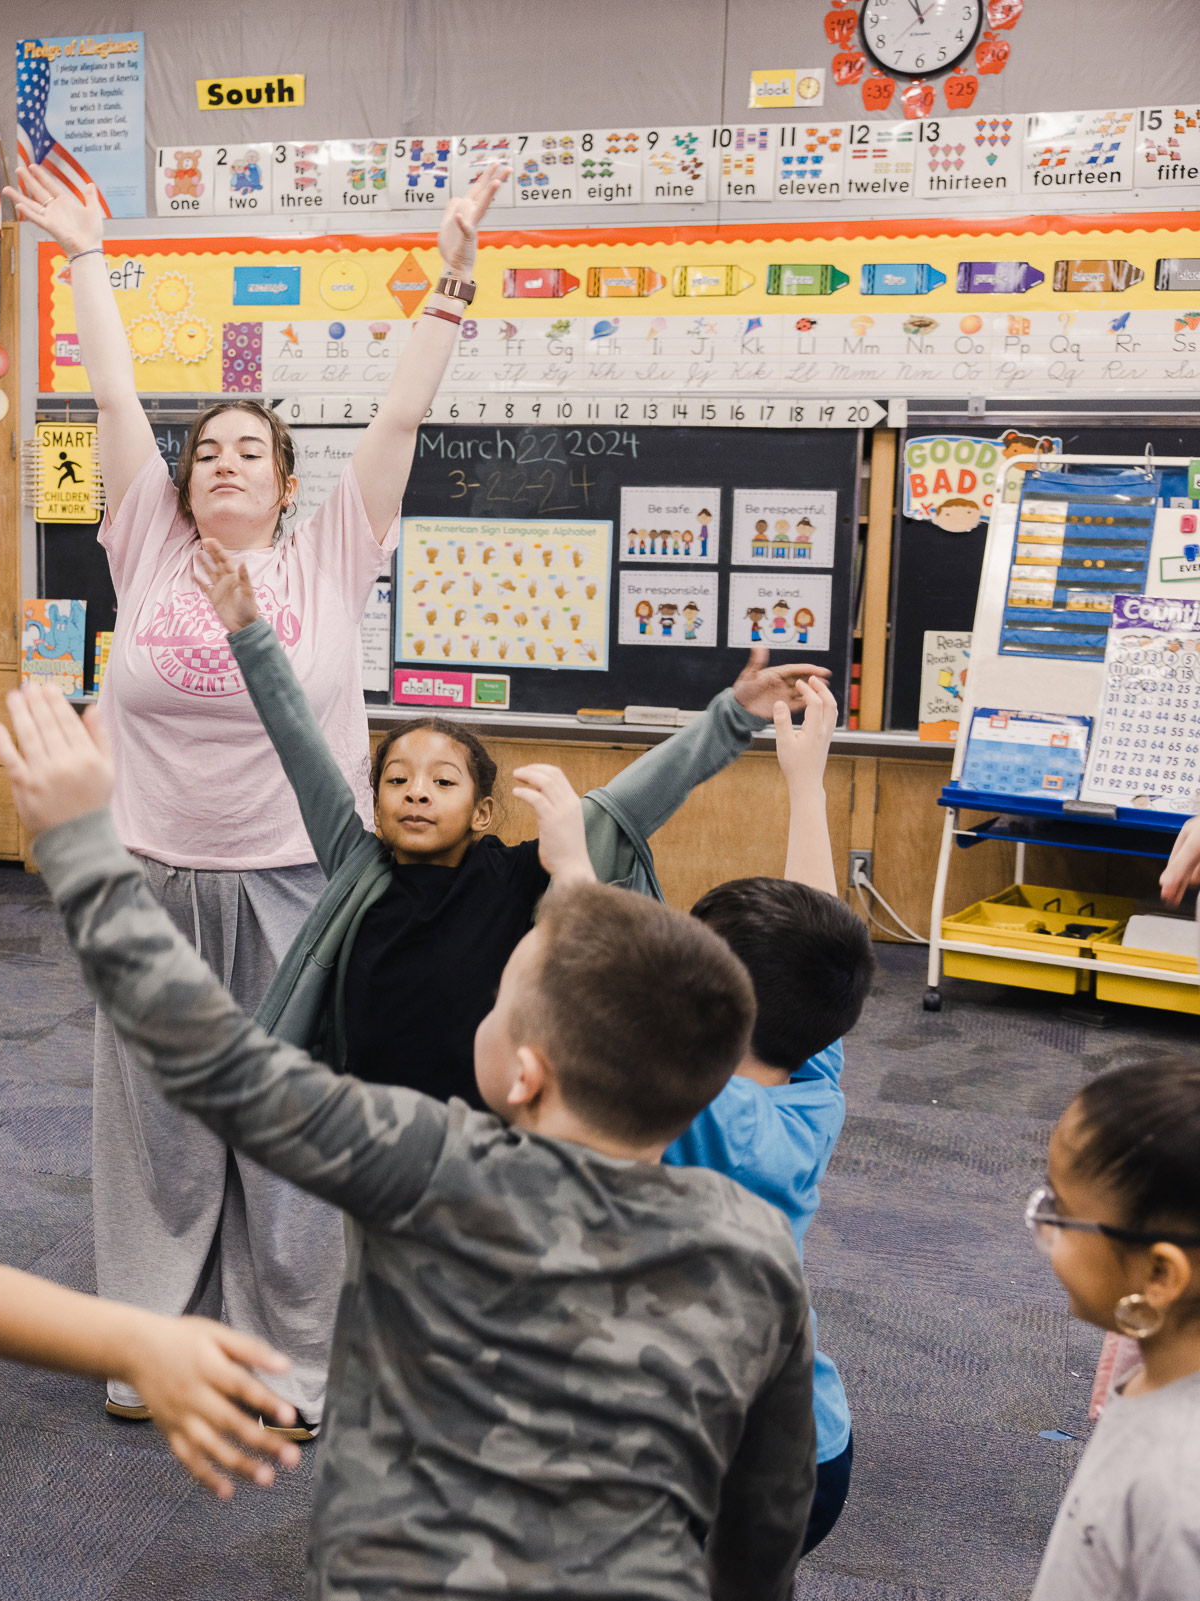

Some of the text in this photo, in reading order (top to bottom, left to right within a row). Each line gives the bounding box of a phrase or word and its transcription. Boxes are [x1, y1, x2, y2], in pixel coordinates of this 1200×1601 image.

[876, 34, 886, 48] 8
[955, 28, 964, 42] 4
[23, 37, 139, 61] Pledge of Allegiance
[937, 47, 947, 61] 5
[915, 54, 925, 68] 6
[207, 79, 295, 106] South
[756, 81, 790, 96] clock
[867, 84, 892, 99] :35
[949, 82, 975, 97] :25
[712, 128, 732, 148] 10
[781, 127, 796, 147] 11
[849, 125, 869, 145] 12
[919, 122, 940, 142] 13
[395, 139, 406, 158] 5
[518, 136, 529, 155] 7
[581, 133, 593, 152] 8
[647, 131, 659, 150] 9
[216, 149, 228, 167] 2
[275, 145, 287, 163] 3
[848, 178, 909, 194] twelve
[929, 174, 1007, 191] thirteen
[1033, 169, 1122, 187] fourteen
[521, 187, 572, 201] seven
[588, 184, 632, 201] eight
[655, 181, 695, 197] nine
[727, 180, 755, 195] ten
[779, 179, 840, 195] eleven
[170, 197, 200, 211] one
[229, 194, 258, 209] two
[281, 192, 323, 208] three
[343, 190, 378, 206] four
[404, 188, 435, 204] five
[690, 276, 721, 287] yellow
[1072, 272, 1105, 282] brown
[954, 337, 984, 354] Oo
[1050, 335, 1085, 361] Qq
[1115, 334, 1141, 352] Rr
[615, 404, 745, 421] 12 13 14 15 16
[43, 431, 93, 448] SMART
[419, 429, 641, 465] March 22 2024
[906, 439, 997, 469] GOOD
[909, 468, 977, 499] BAD
[44, 491, 91, 502] CHILDREN
[48, 504, 87, 514] AT WORK
[648, 505, 692, 514] Be safe.
[745, 505, 760, 514] Be
[415, 524, 597, 538] The American Sign Language Alphabet
[758, 588, 773, 598] Be
[937, 634, 972, 650] Read
[22, 660, 84, 674] KINDNESS
[156, 647, 225, 693] YOU WANT
[403, 678, 461, 699] chalk tray
[1134, 739, 1182, 751] 63 64 65
